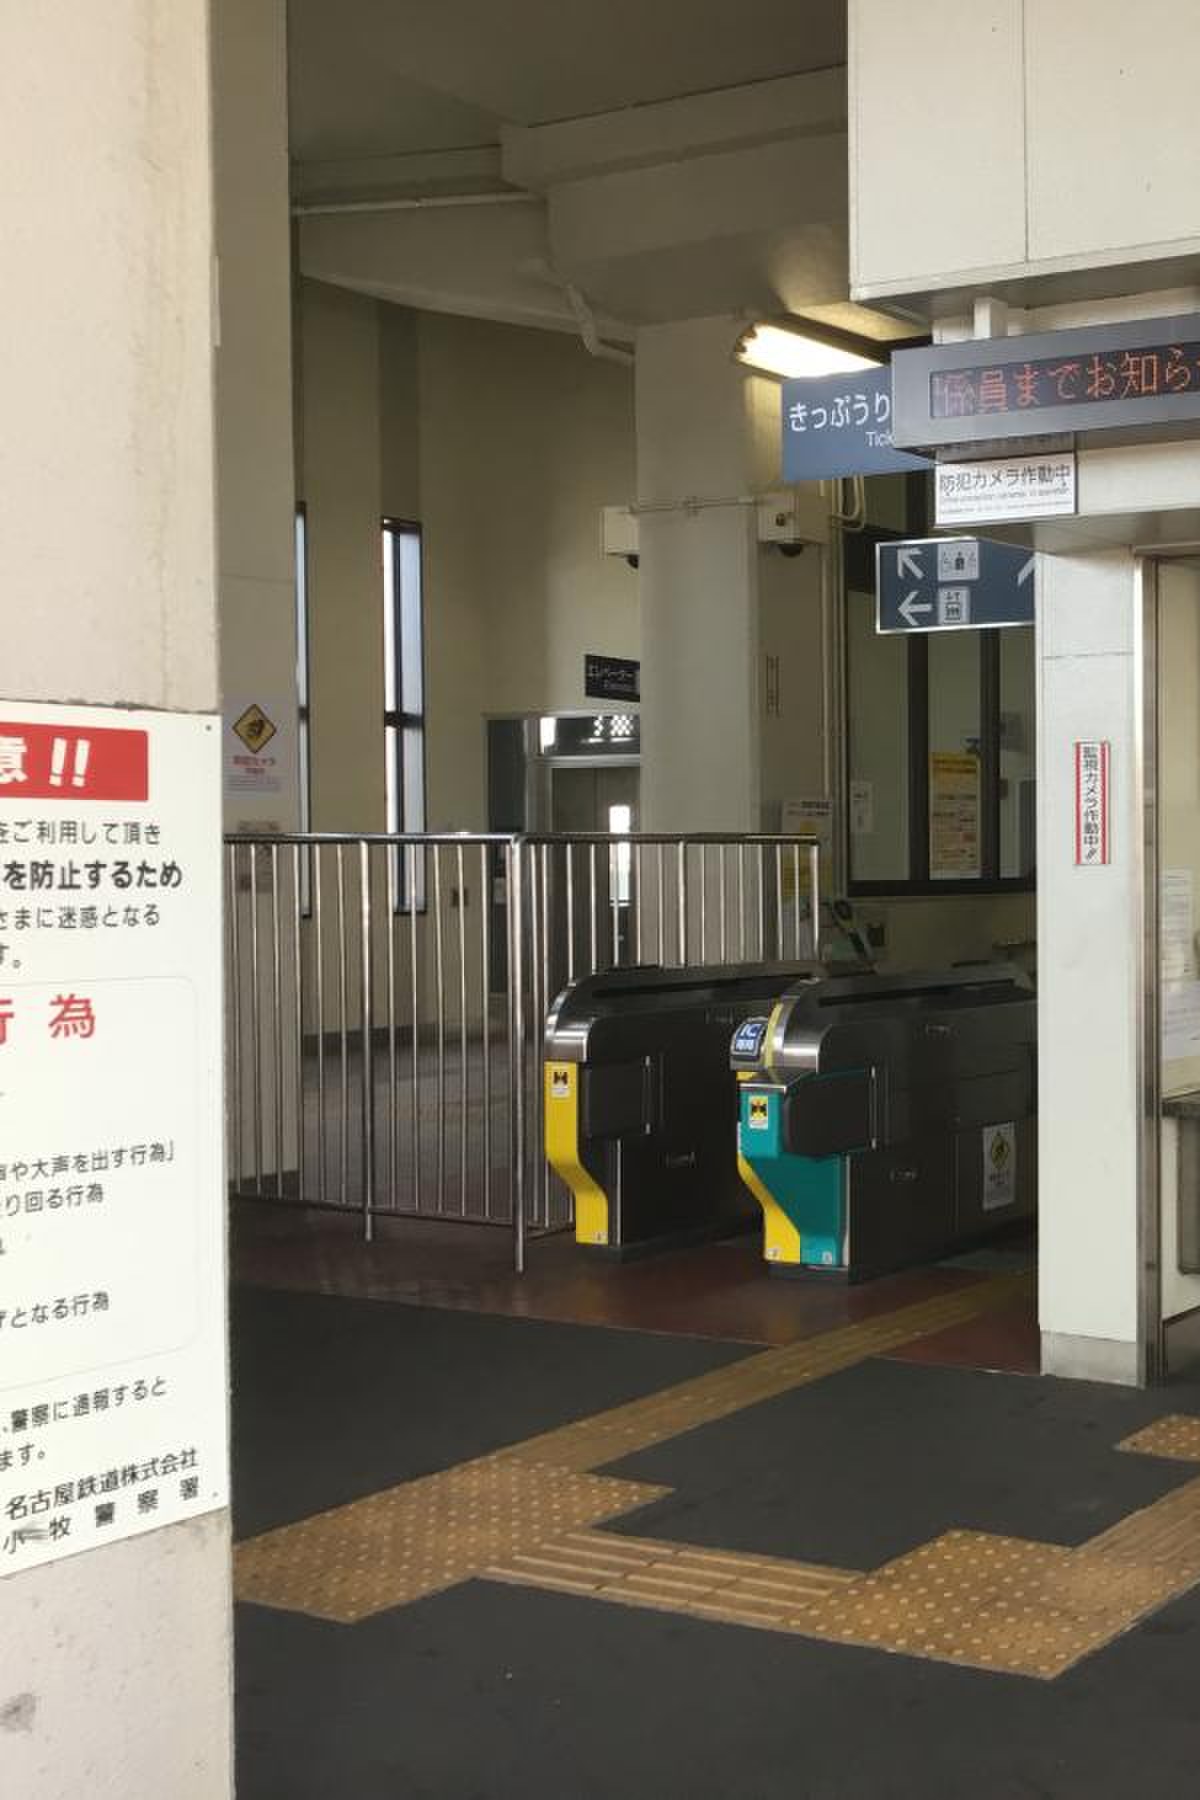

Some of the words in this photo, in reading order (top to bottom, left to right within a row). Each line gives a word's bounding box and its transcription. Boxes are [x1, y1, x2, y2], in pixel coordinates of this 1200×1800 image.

[789, 392, 890, 432] きっぷうり
[940, 463, 1071, 494] 防犯カメラ作動中
[3, 859, 183, 891] を防止するため
[5, 1447, 199, 1521] 名古屋鉄道株式会社
